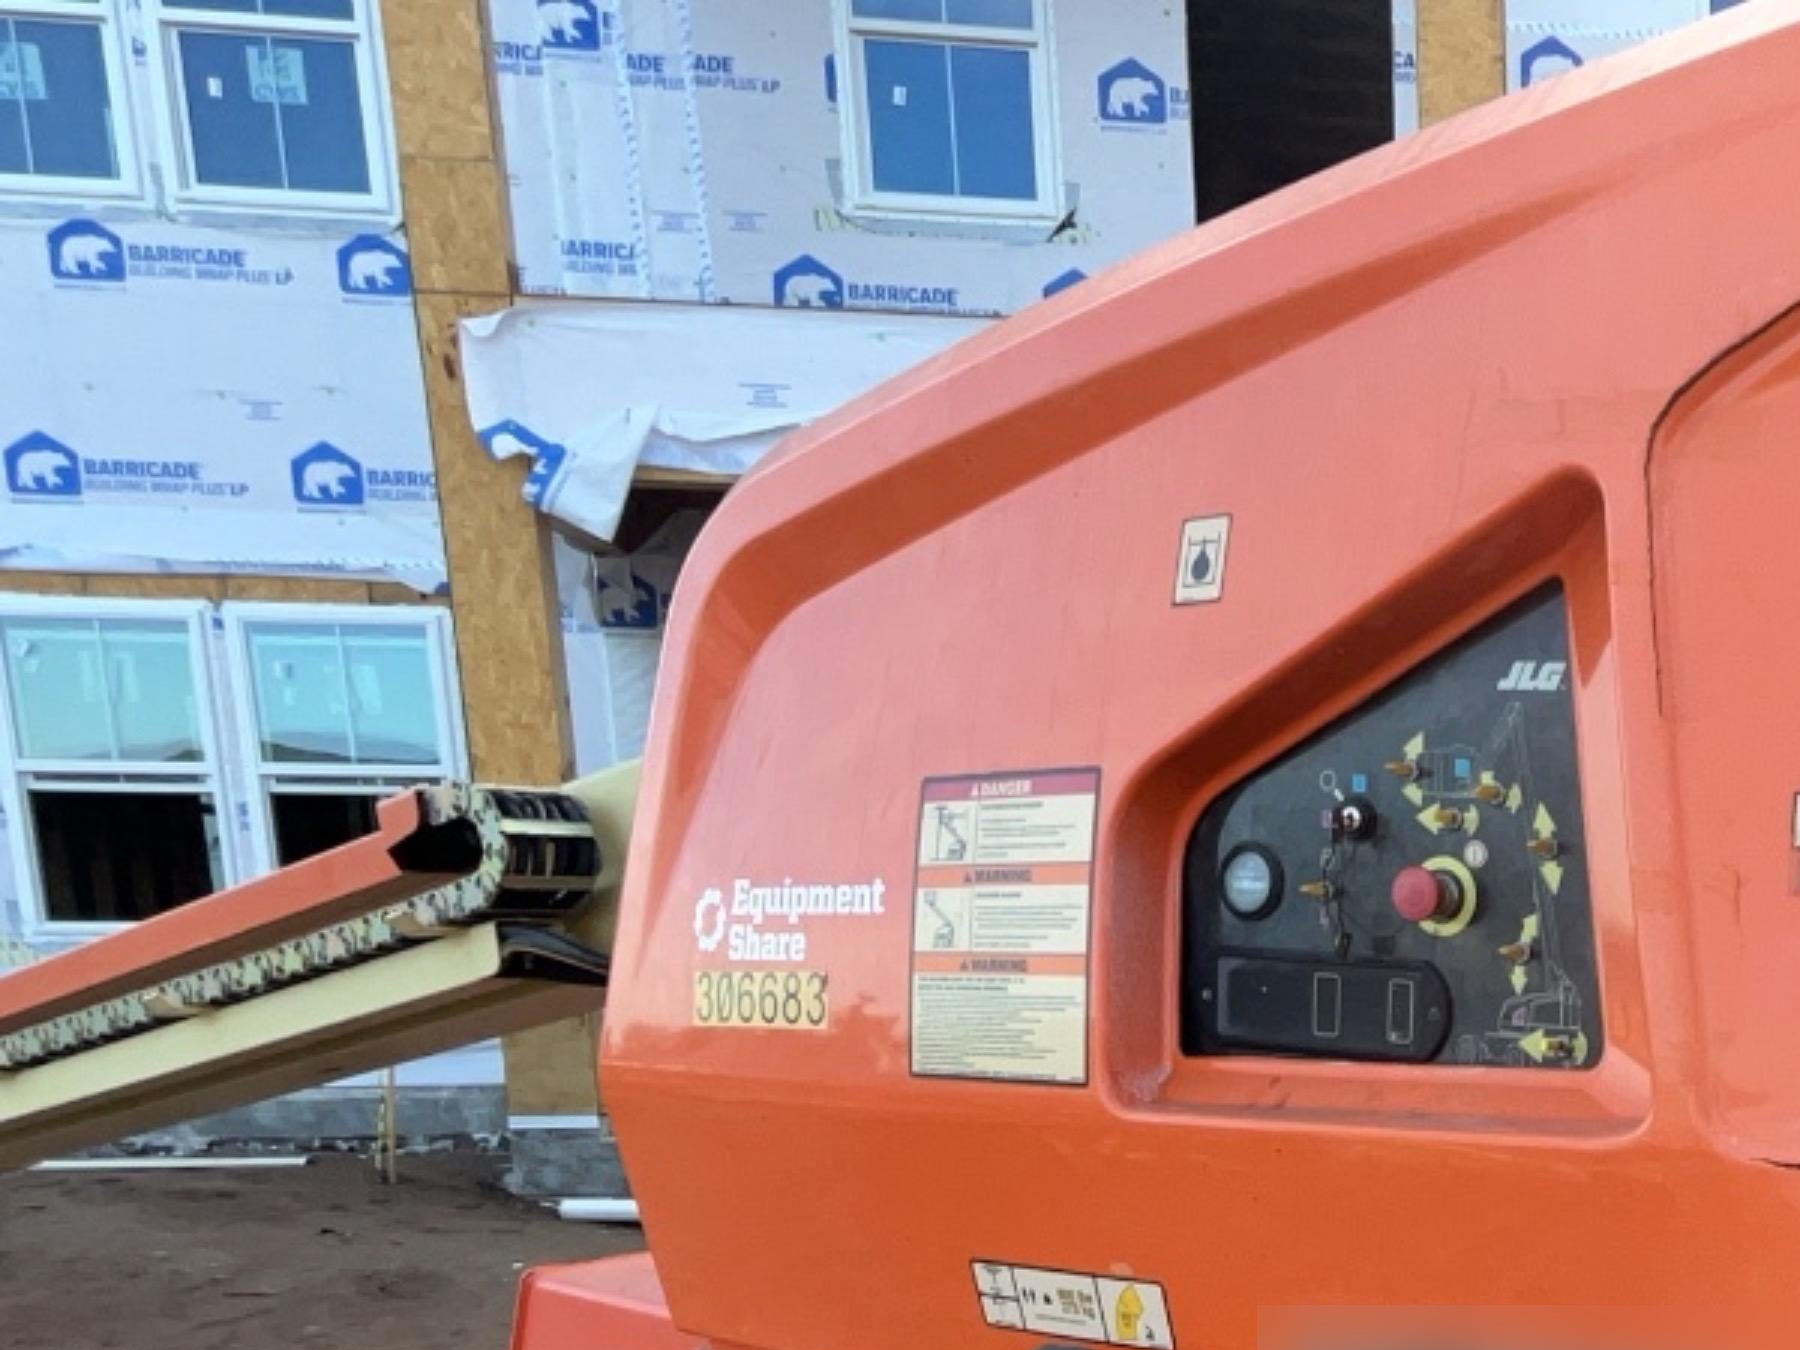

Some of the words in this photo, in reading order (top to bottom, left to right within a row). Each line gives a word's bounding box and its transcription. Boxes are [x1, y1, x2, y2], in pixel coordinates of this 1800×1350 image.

[128, 245, 249, 268] BARRICADE
[848, 284, 958, 307] BARRICADE
[83, 459, 202, 480] BARRICADE
[1497, 660, 1566, 691] JLG
[980, 780, 1032, 796] DANGER
[974, 870, 1032, 884] WARNING
[732, 877, 886, 924] Equipment
[729, 923, 807, 961] Share
[970, 959, 1028, 973] WARNING
[696, 971, 829, 1025] 306683
